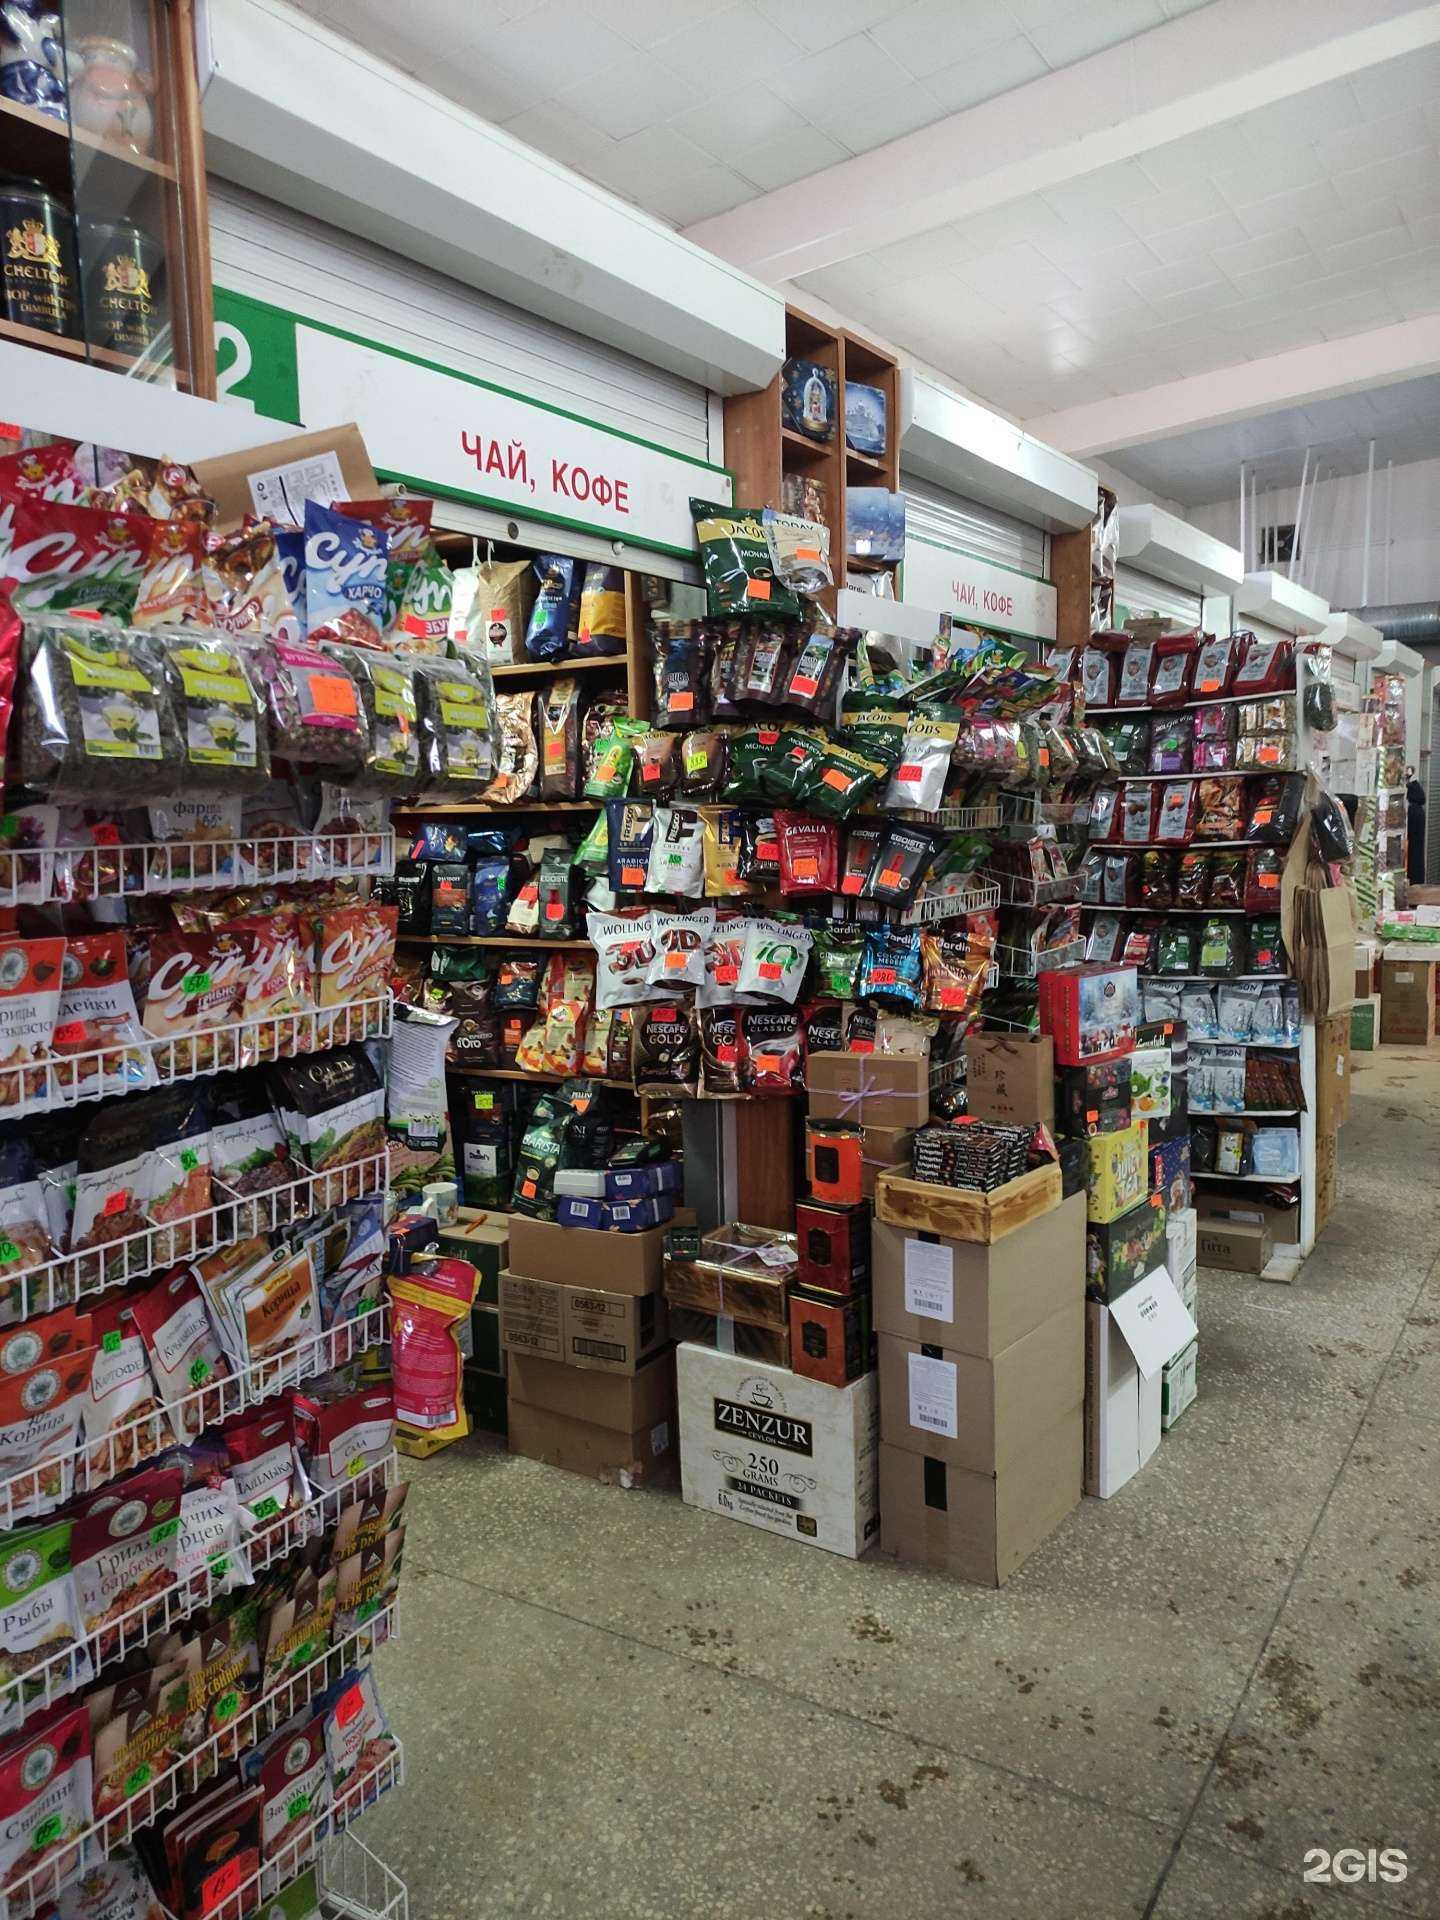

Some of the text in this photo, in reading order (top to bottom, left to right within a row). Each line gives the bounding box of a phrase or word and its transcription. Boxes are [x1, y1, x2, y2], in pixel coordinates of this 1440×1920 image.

[462, 431, 630, 514] ЧАЙ, КОФЕ
[306, 531, 388, 594] Суп
[346, 585, 383, 600] ХАРЧО
[983, 591, 1013, 616] КОФЕ
[856, 713, 893, 724] JACOBS
[785, 825, 827, 837] GEVALIA
[603, 921, 651, 936] WOLLING
[938, 940, 971, 952] Jardin
[750, 1024, 793, 1032] CLASSIC
[649, 1033, 684, 1045] GOLD
[522, 1133, 561, 1155] BARISTA
[718, 1403, 808, 1446] ZENZUR
[747, 1431, 777, 1445] CEYLON
[748, 1453, 779, 1476] 250
[743, 1469, 779, 1487] GRAMS
[750, 1485, 793, 1506] PACKETS
[3, 1598, 54, 1634] Рыбы
